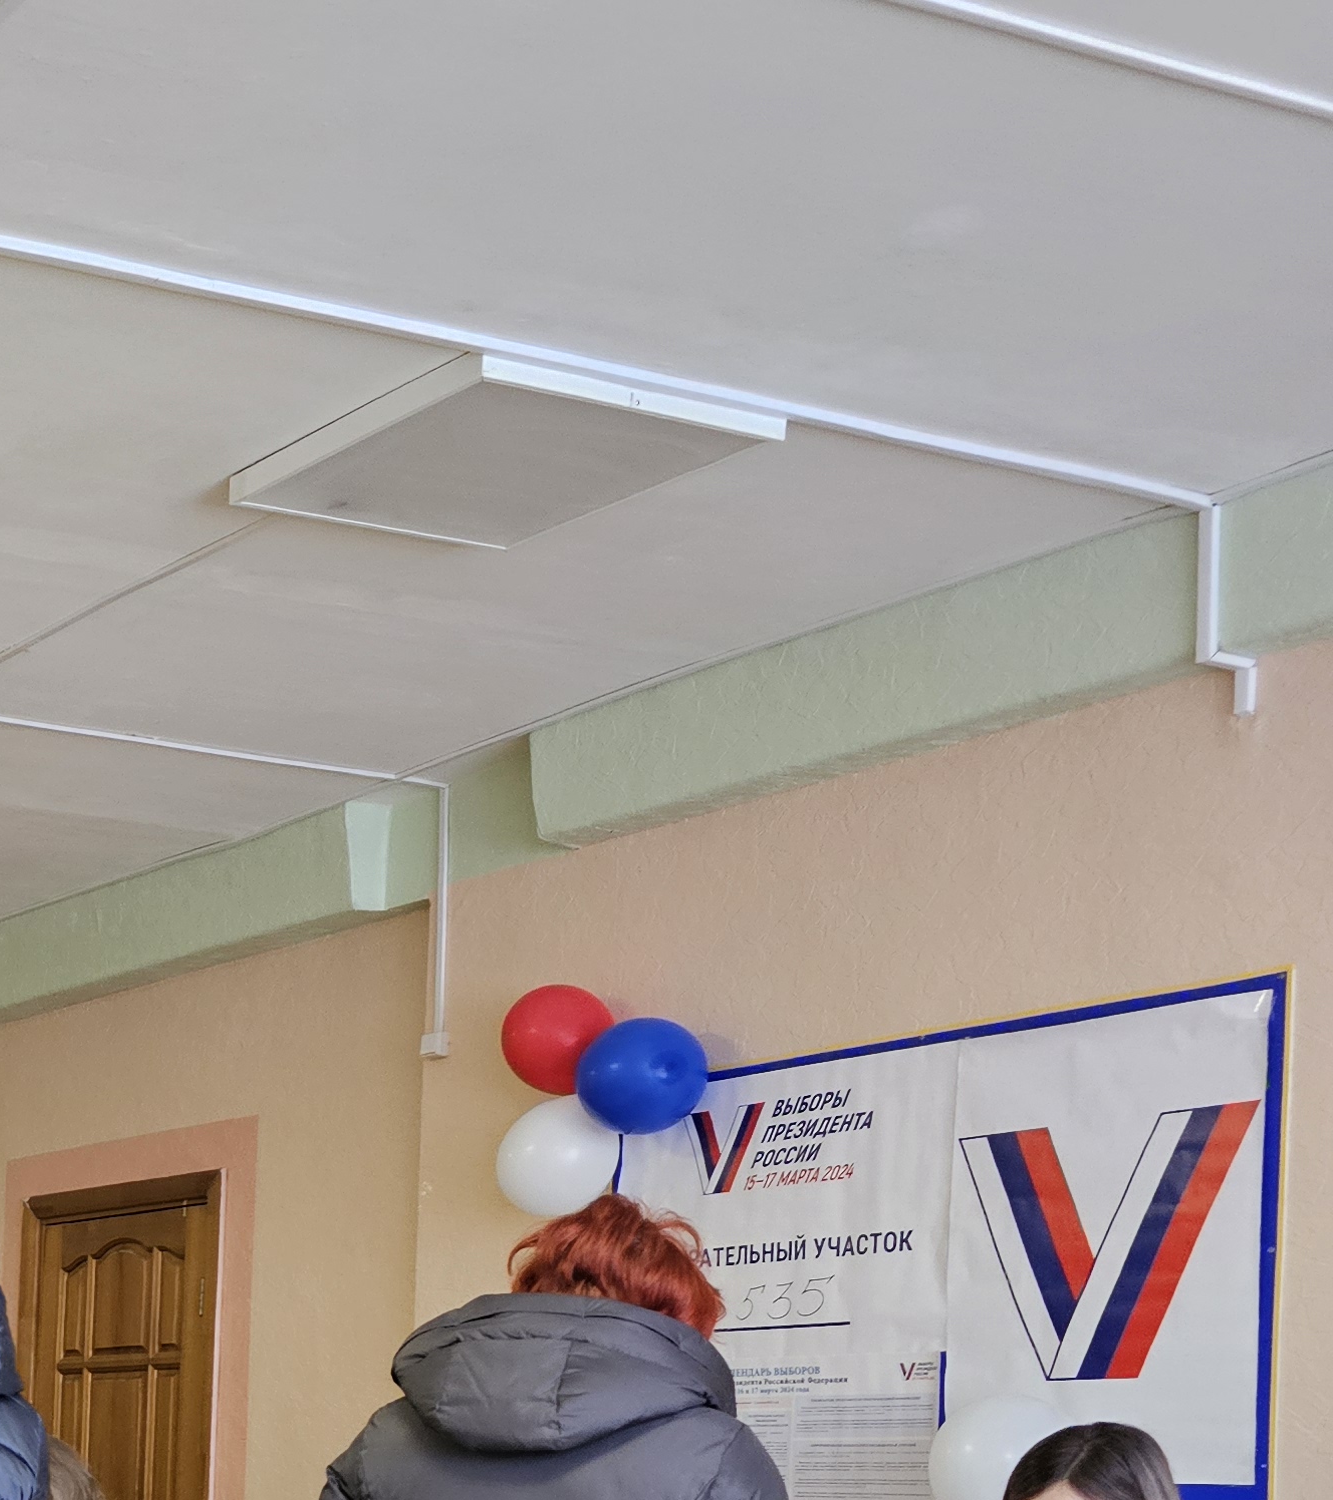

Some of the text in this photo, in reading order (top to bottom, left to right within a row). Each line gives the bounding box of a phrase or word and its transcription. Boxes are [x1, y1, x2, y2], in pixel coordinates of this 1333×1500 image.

[771, 1088, 852, 1118] ВЫБОРЫ
[761, 1111, 875, 1144] ПРЕЗИДЕНТА
[750, 1143, 823, 1169] РОССИИ
[777, 1167, 821, 1187] МАРТА
[821, 1163, 855, 1182] 2024
[814, 1229, 914, 1260] УЧАСТОК
[735, 1274, 836, 1321] 535
[774, 1366, 821, 1376] ВЫБОРОВ
